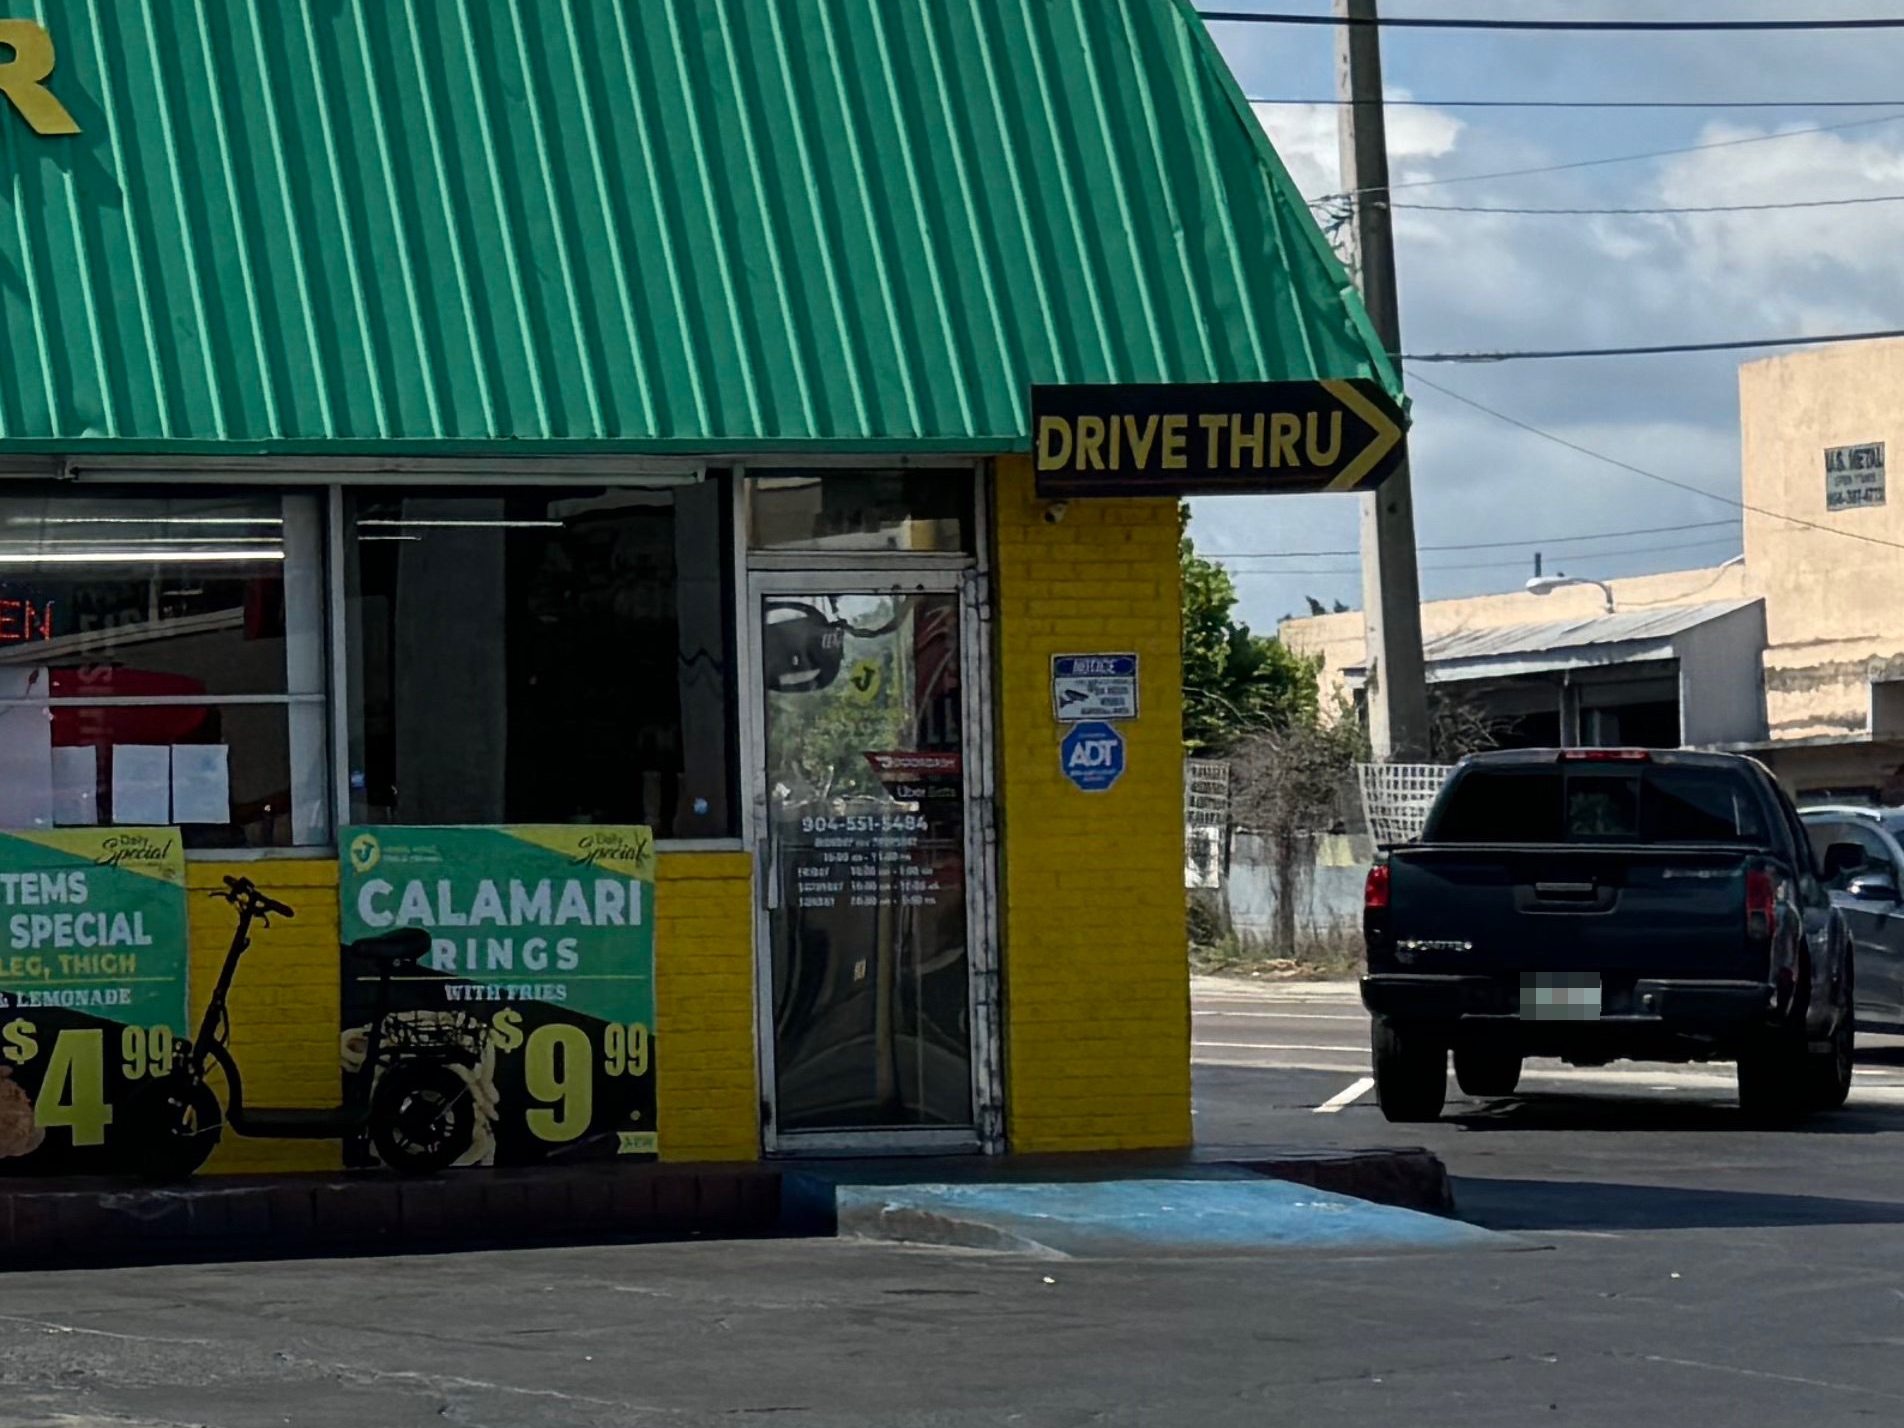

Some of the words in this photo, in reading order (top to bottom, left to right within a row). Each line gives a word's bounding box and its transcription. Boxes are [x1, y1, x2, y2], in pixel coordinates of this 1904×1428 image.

[1039, 414, 1189, 470] DRIVE
[1199, 411, 1343, 468] THRU
[1069, 740, 1118, 767] ADT
[896, 786, 926, 798] Uber
[95, 837, 172, 866] Special
[569, 835, 649, 870] Special
[358, 878, 642, 927] CALAMARI
[10, 912, 152, 948] SPECIAL
[58, 954, 137, 973] THIGH
[432, 938, 579, 971] RINGS
[17, 989, 131, 1008] LEMONADE
[445, 984, 499, 1001] WITH
[503, 984, 567, 1001] FRIES
